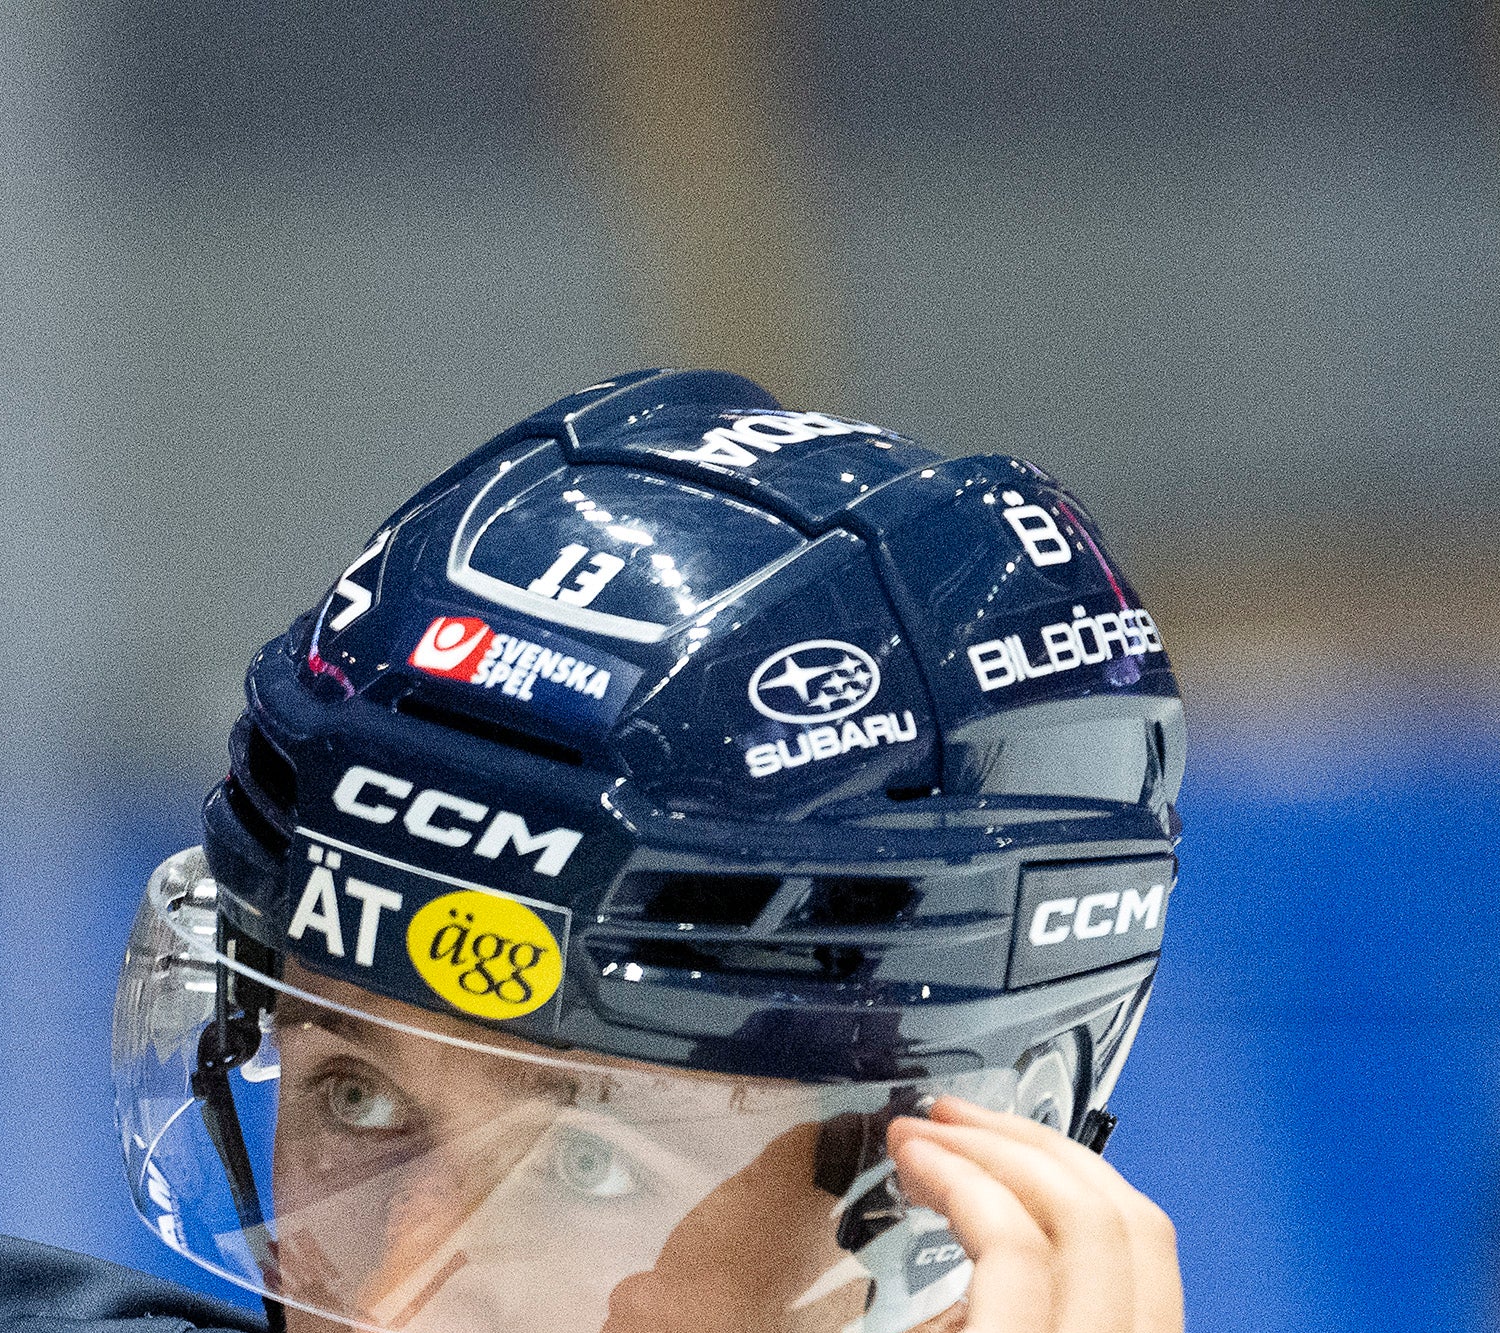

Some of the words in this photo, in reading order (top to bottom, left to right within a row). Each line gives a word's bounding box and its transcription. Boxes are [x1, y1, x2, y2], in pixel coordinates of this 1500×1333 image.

[527, 542, 626, 608] 13
[470, 657, 535, 702] SPEL
[484, 632, 612, 700] SVENSKA
[968, 606, 1165, 692] BILBÖRSE
[746, 711, 918, 778] SUBARU
[332, 765, 584, 878] CCM
[287, 844, 404, 968] ÄT
[428, 907, 550, 1005] ägg
[1028, 884, 1163, 946] CCM
